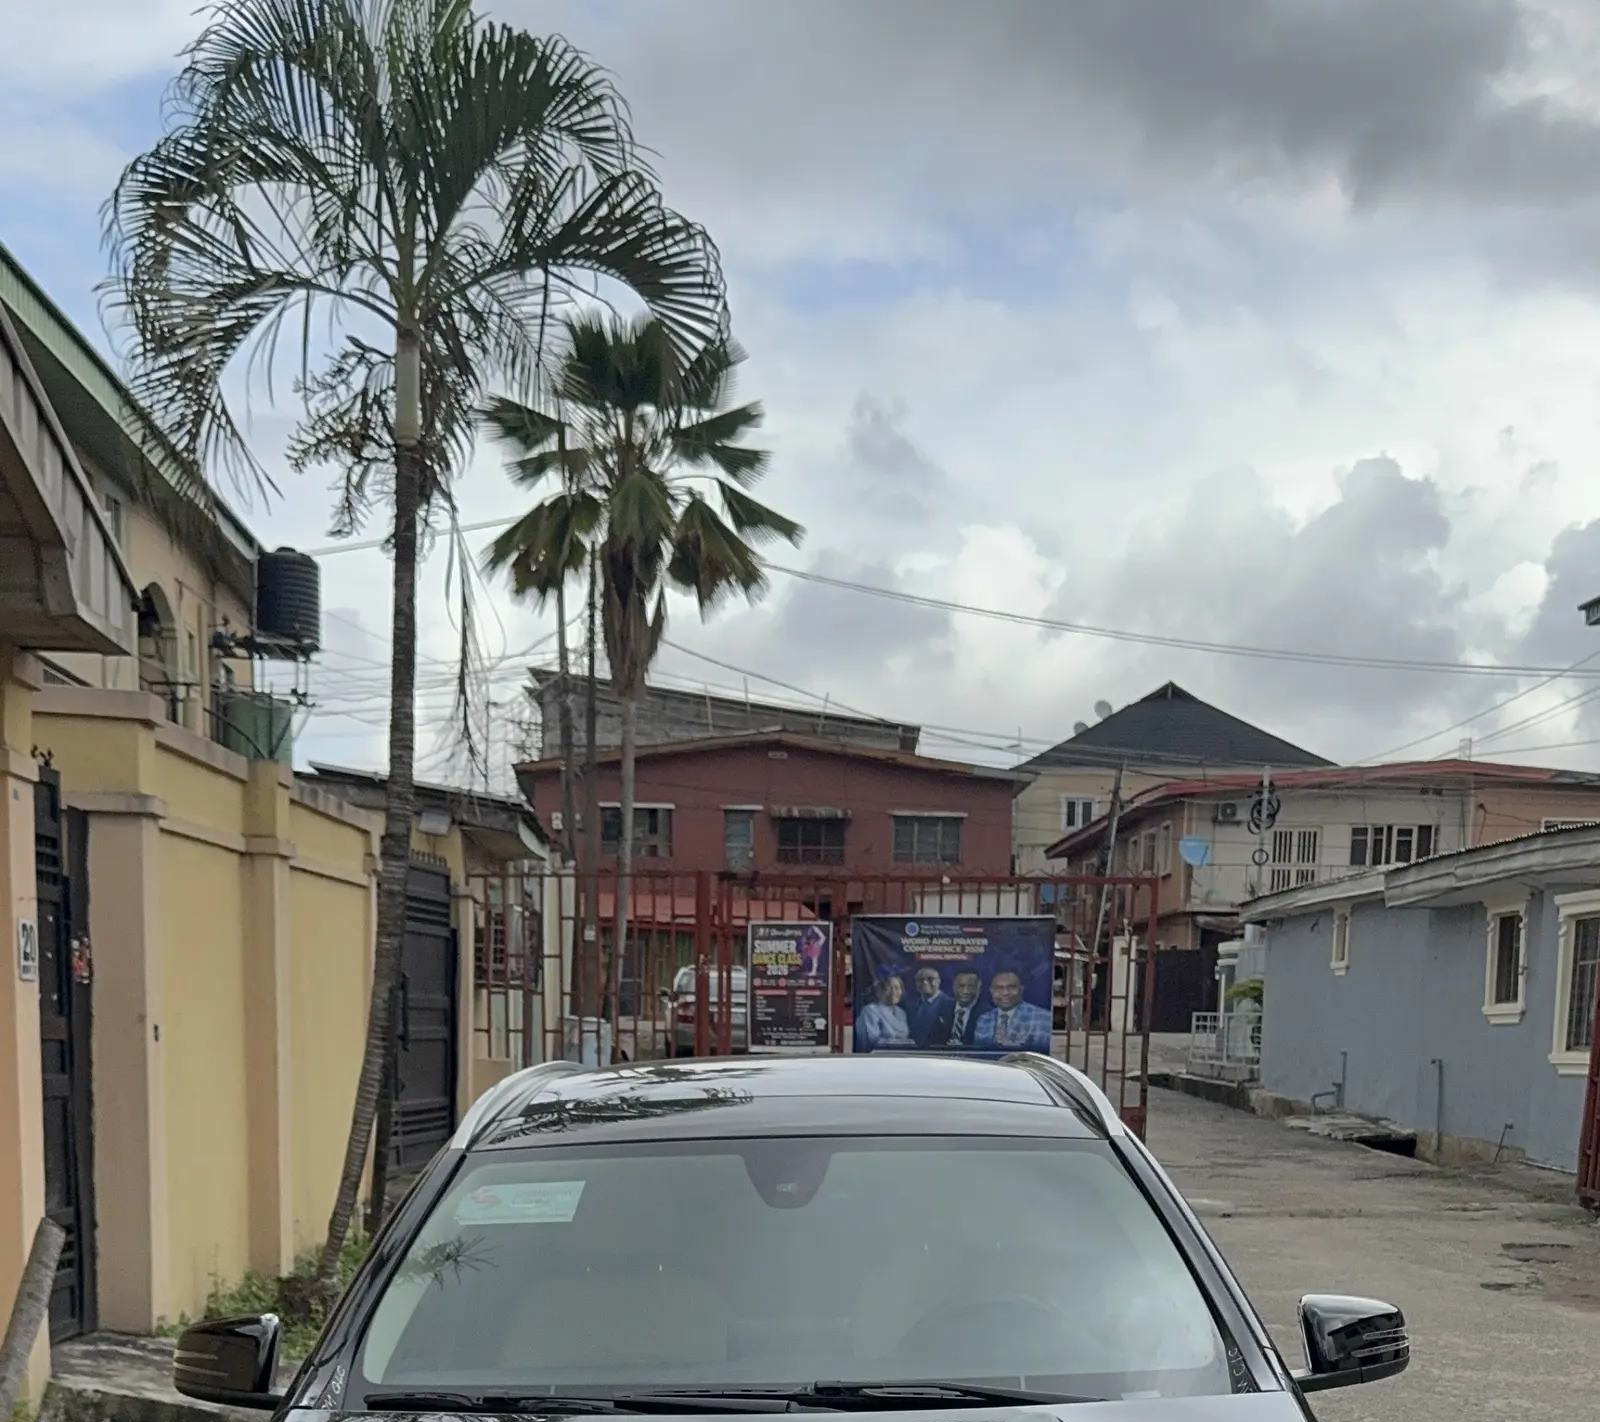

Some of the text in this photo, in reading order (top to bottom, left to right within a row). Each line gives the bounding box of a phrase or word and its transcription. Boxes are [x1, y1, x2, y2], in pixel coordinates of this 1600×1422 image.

[22, 922, 36, 963] 20
[753, 939, 798, 953] SUMMER
[900, 938, 989, 946] WORD AND PRAYER
[903, 945, 962, 953] CONFERENCE
[752, 953, 802, 966] DANCE CLASS
